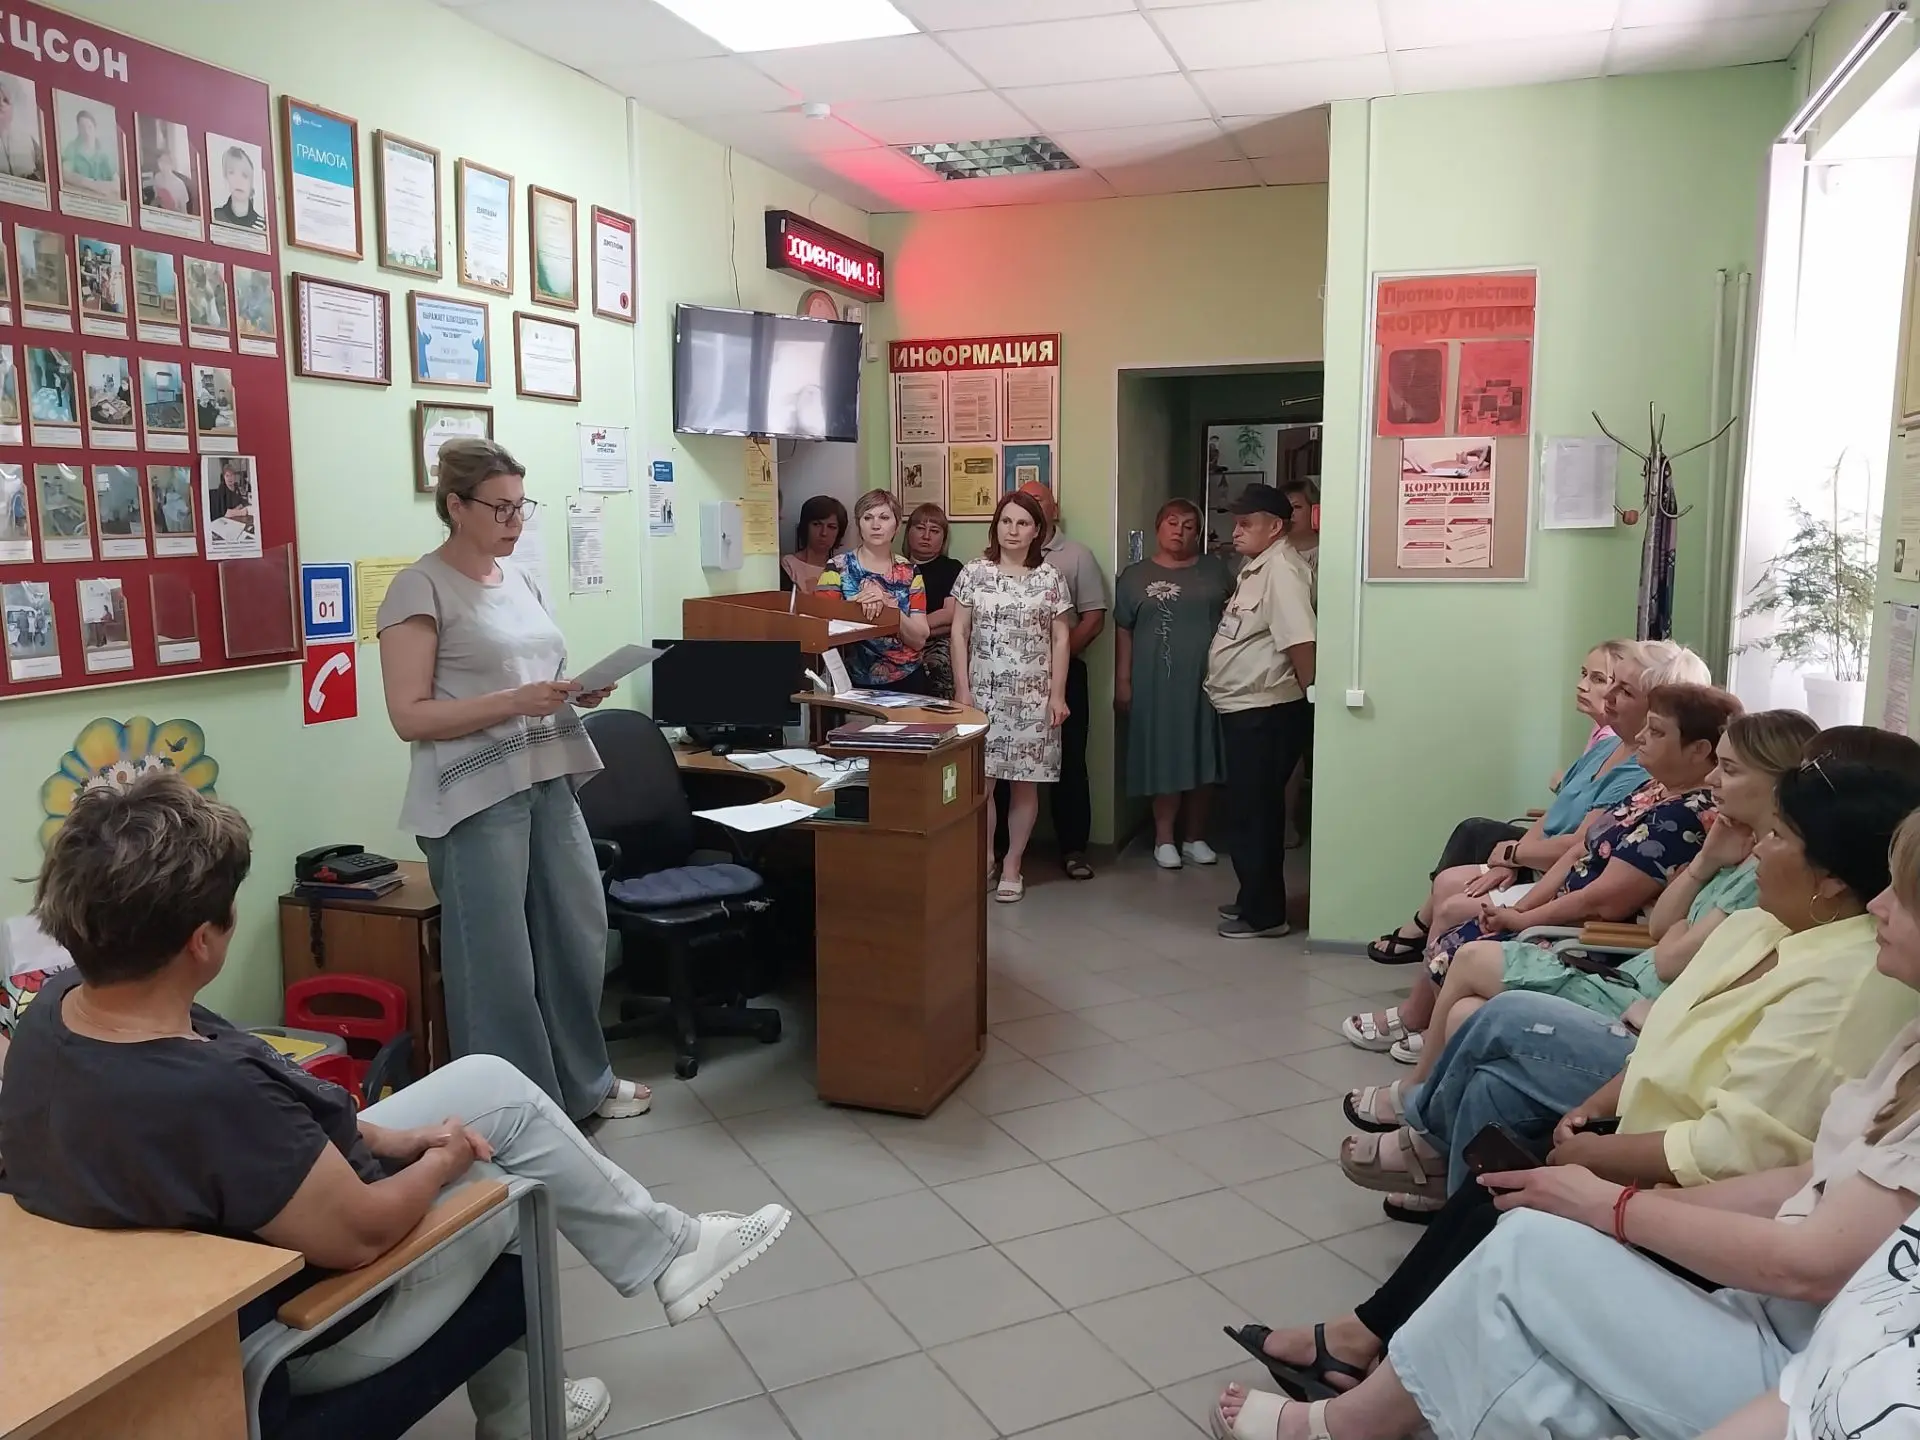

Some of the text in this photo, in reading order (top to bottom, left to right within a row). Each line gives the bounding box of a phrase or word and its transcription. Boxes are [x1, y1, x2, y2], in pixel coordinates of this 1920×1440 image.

[296, 143, 348, 171] ГРАМОТА
[866, 262, 874, 286] В
[893, 340, 1054, 368] ИНФОРМАЦИЯ
[1404, 482, 1490, 493] КОРРУПЦИЯ
[319, 601, 336, 618] 01
